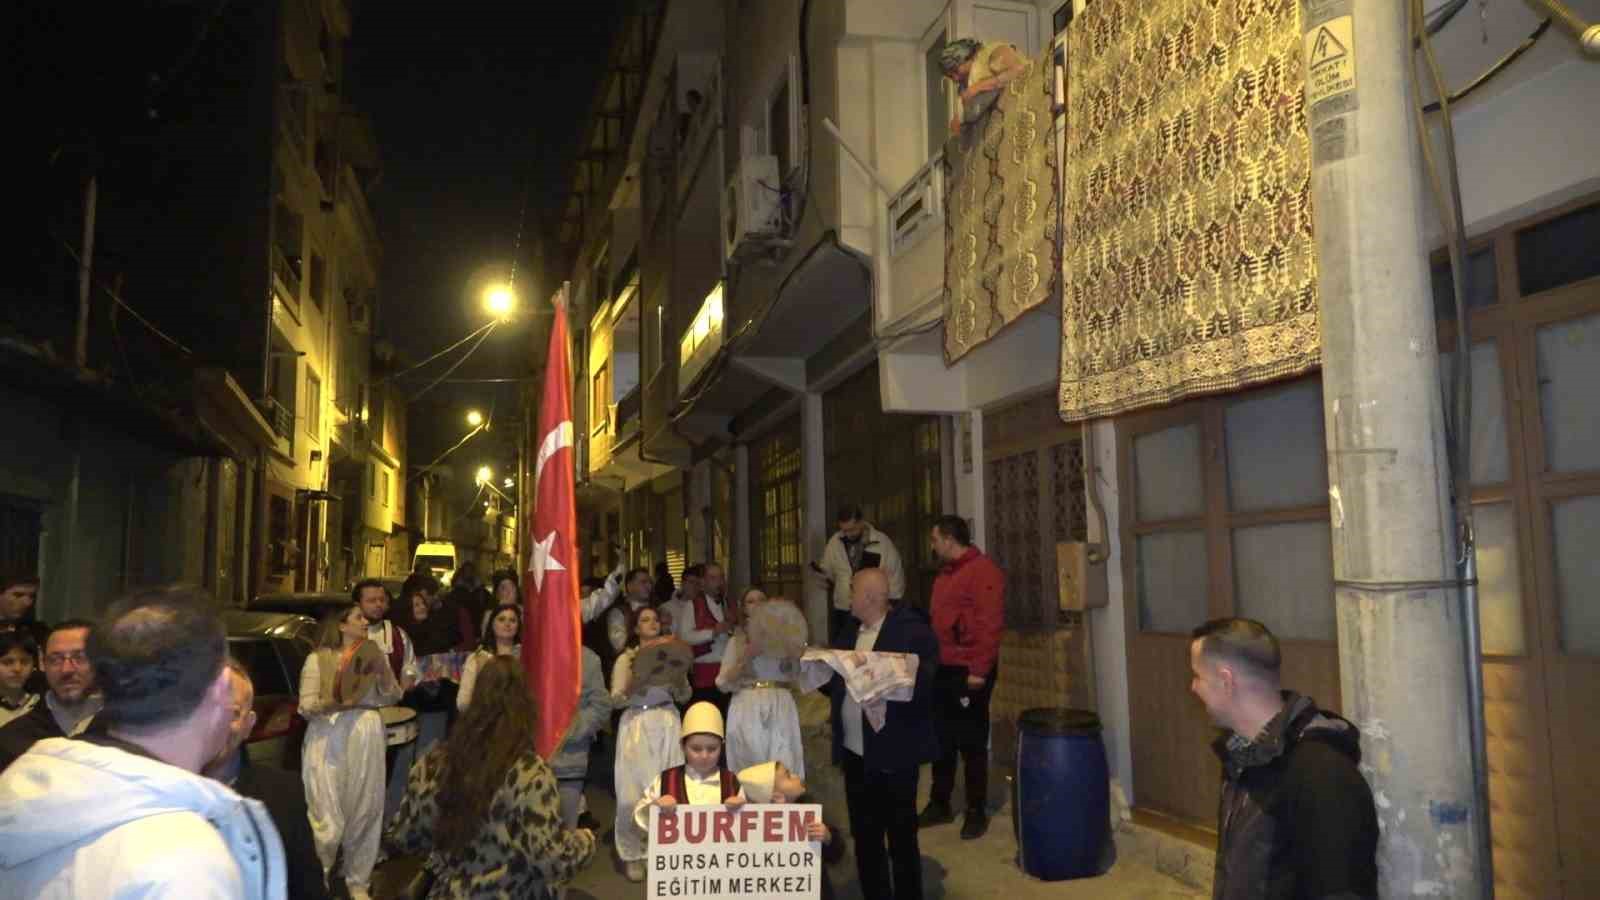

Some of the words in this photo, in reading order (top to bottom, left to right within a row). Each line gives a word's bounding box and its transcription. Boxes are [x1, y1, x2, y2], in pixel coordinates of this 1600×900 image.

[657, 810, 816, 844] BURFEM
[656, 853, 720, 871] BURSA
[726, 851, 814, 868] FOLKLOR
[657, 876, 721, 897] EĞİTİM
[729, 873, 812, 894] MERKEZİ
